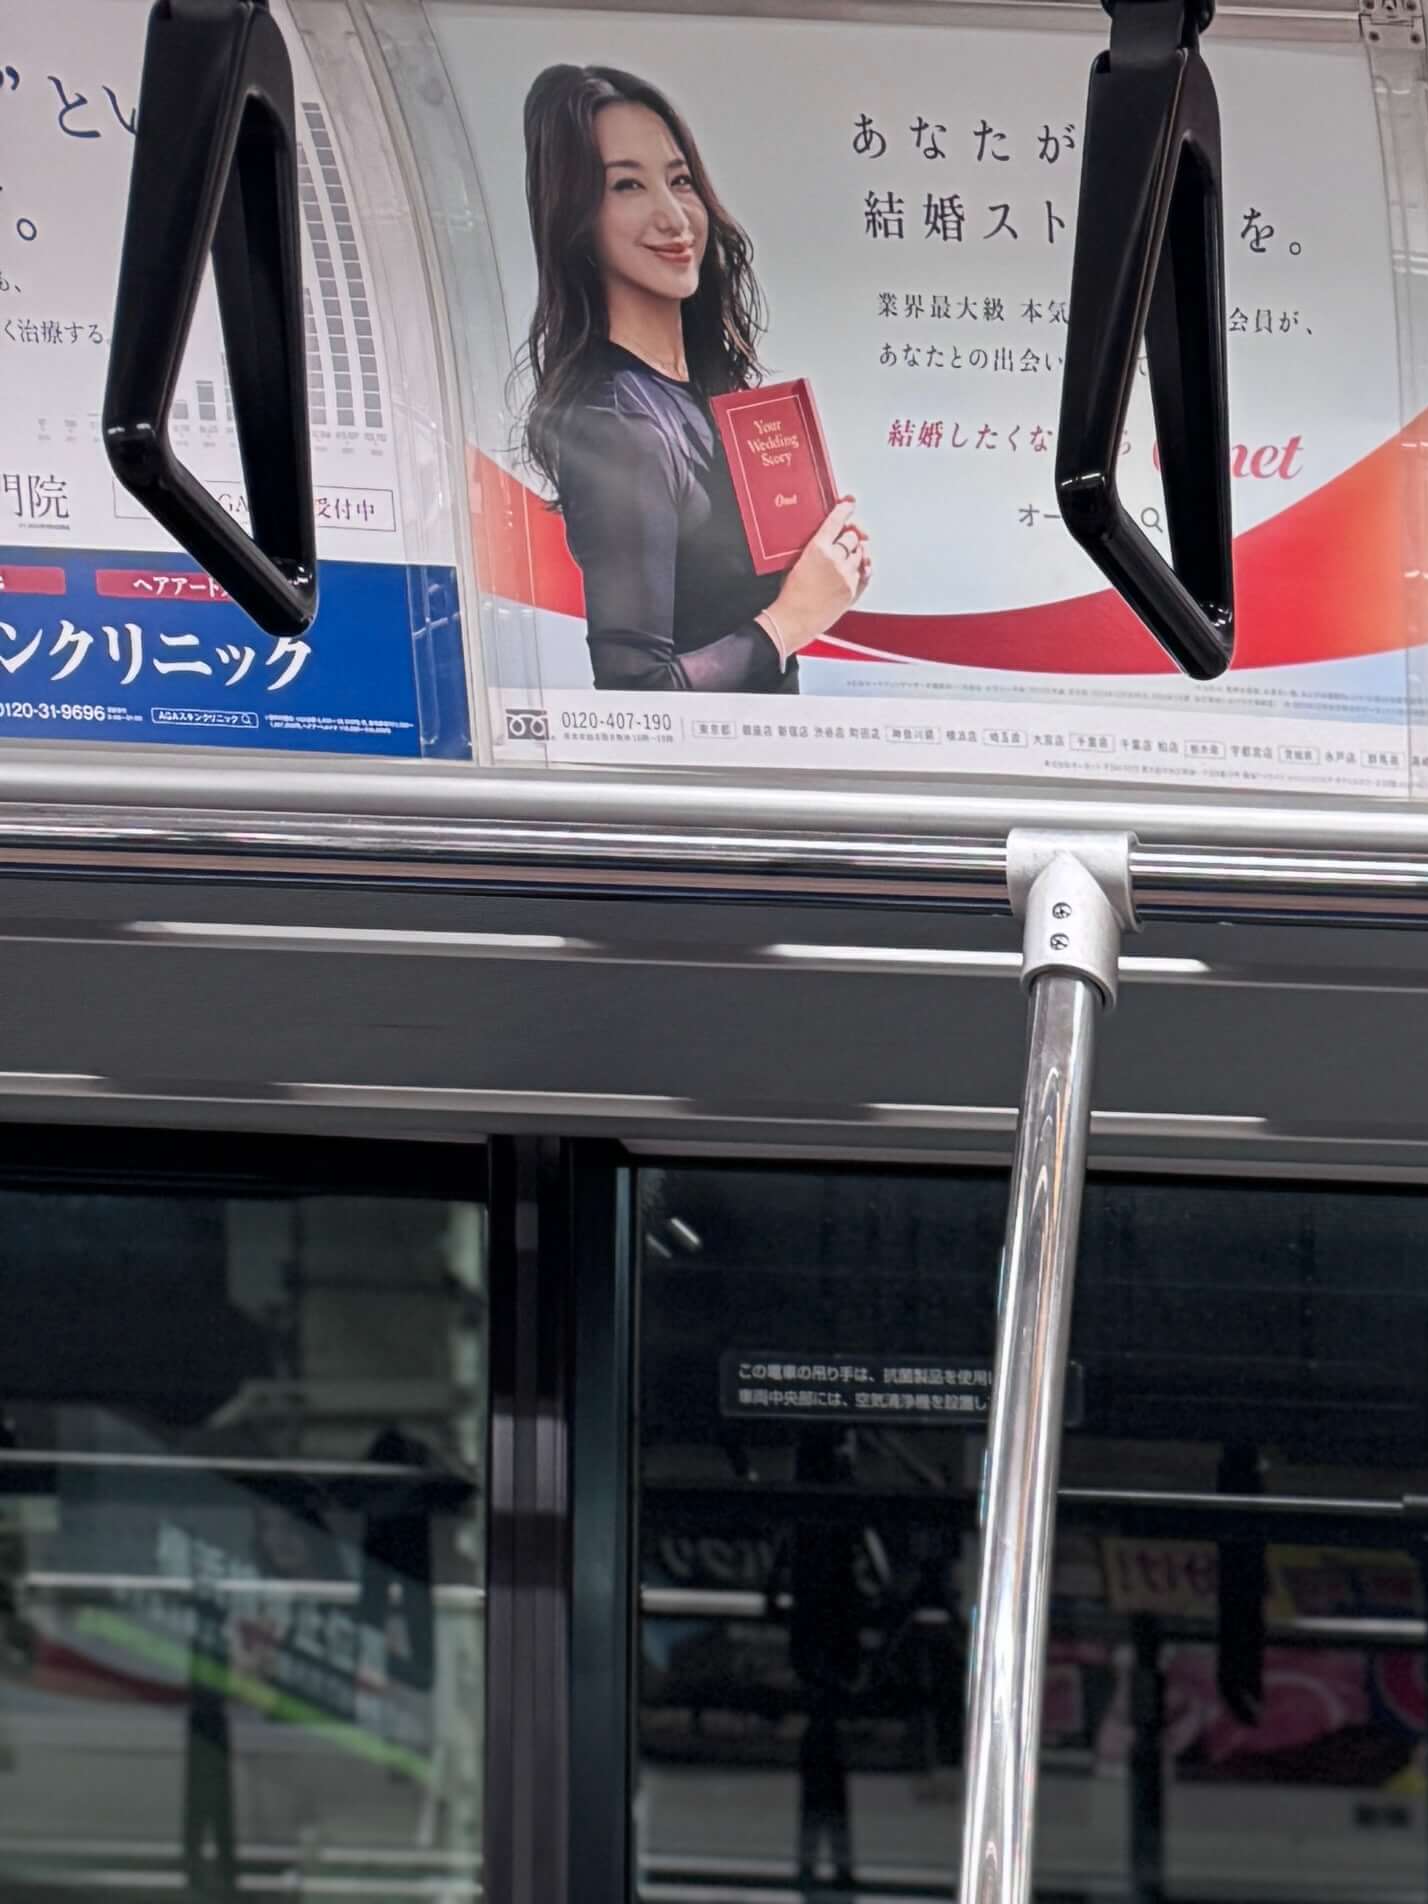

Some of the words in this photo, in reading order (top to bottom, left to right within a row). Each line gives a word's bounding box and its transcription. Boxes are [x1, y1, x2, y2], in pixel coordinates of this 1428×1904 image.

[853, 113, 1075, 164] あなたが
[877, 292, 1005, 322] 業界最大級
[561, 710, 672, 732] 0120-407-190
